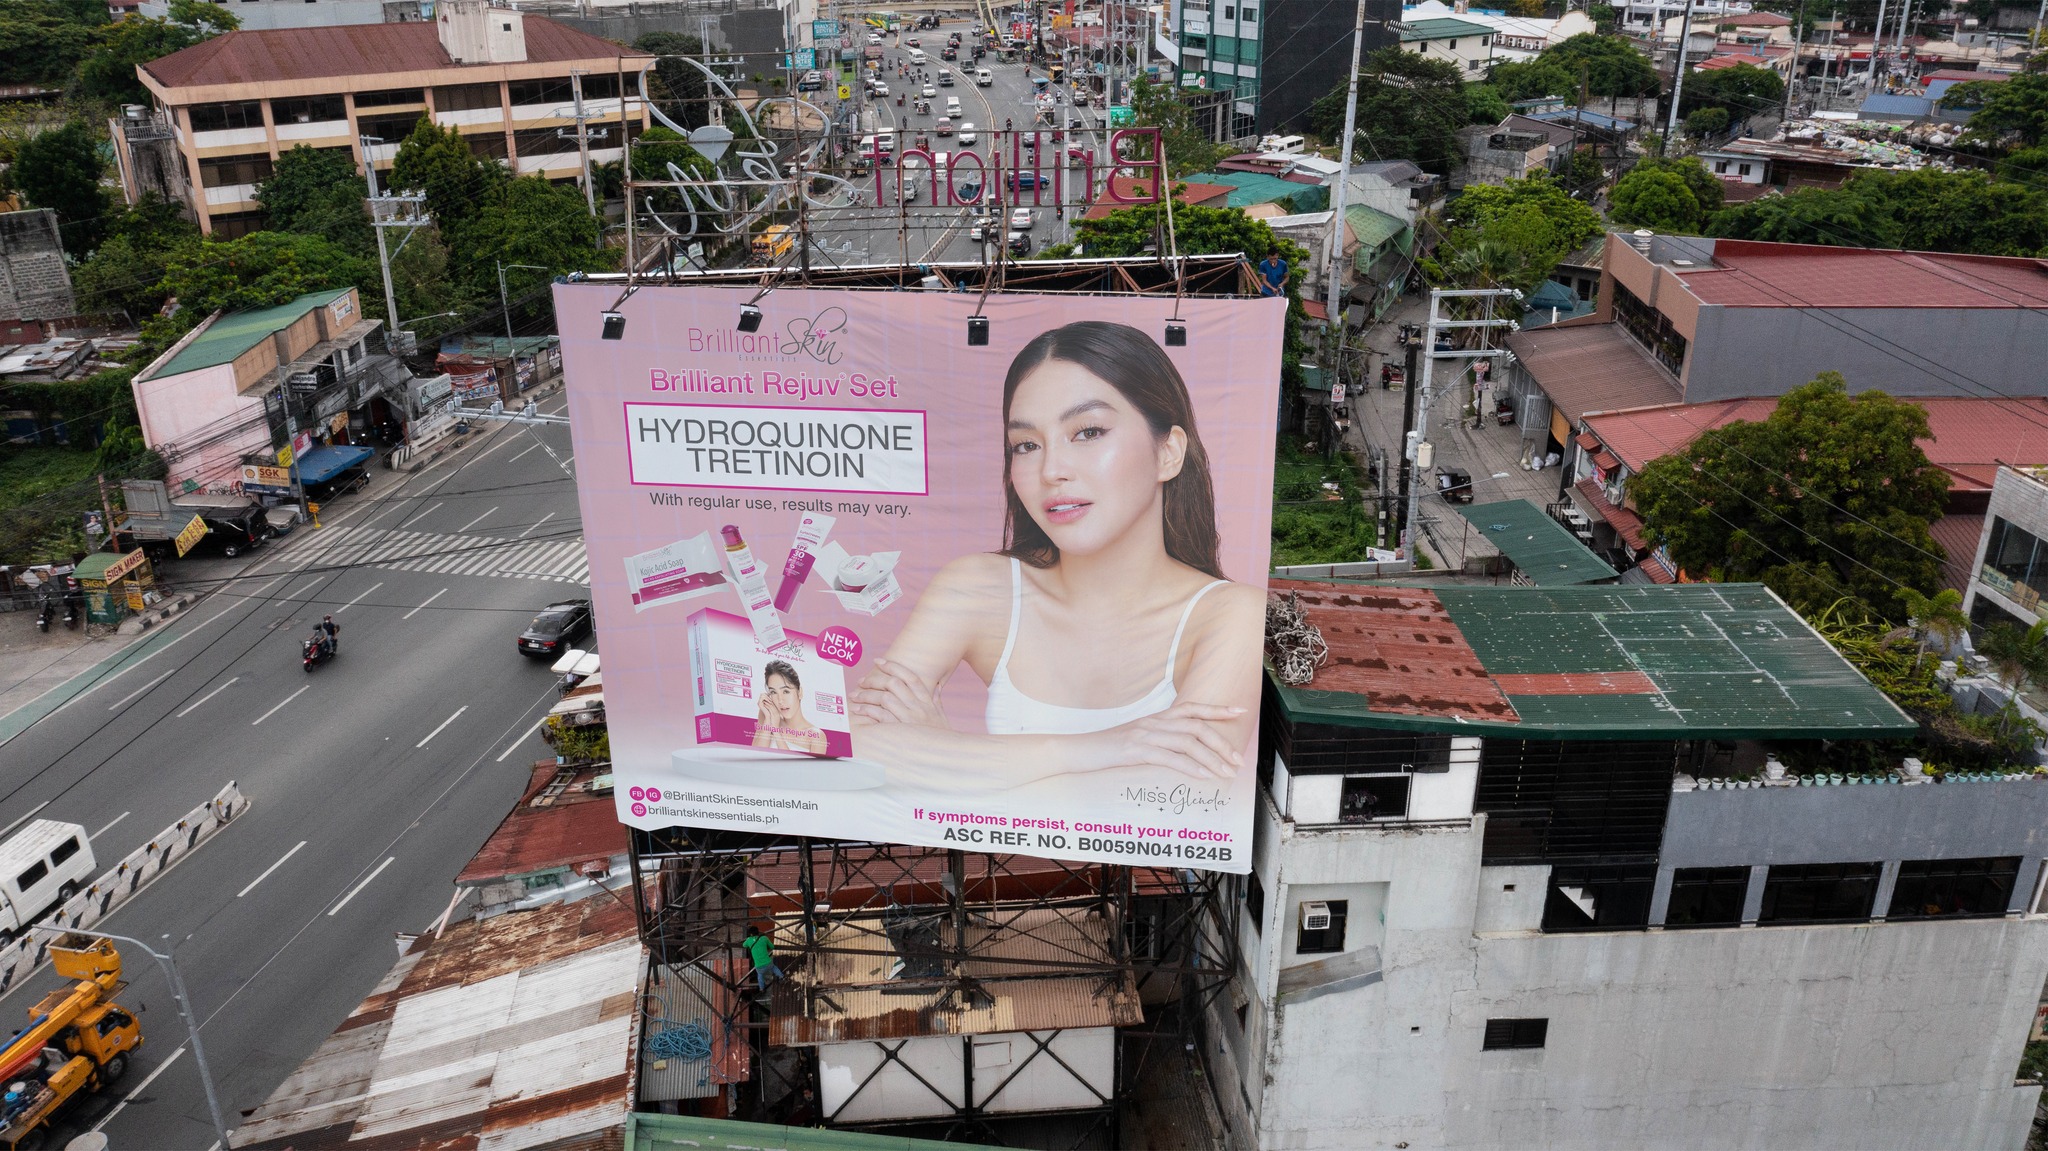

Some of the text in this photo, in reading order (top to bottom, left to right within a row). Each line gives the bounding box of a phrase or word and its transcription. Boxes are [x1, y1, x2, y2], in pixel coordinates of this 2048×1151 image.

[688, 327, 781, 354] Brilliant
[739, 354, 797, 362] Essentials
[650, 368, 753, 394] Brilliant
[850, 373, 898, 398] Set
[638, 418, 913, 451] HYDROQUINONE
[260, 468, 280, 477] SGK
[686, 448, 864, 478] TRETINOIN
[650, 492, 912, 518] With regular use, results may vary.
[106, 550, 144, 581] SIGN MAKER
[640, 558, 684, 577] Kojic Acid Soap
[82, 580, 107, 588] SIGN
[823, 632, 858, 650] NEW
[820, 643, 854, 662] LOOK
[754, 722, 784, 734] Brilliant
[785, 726, 806, 738] Rejuv
[807, 730, 820, 739] Set
[663, 790, 819, 810] @BrilliantSkinEssentialsMain
[1126, 786, 1167, 803] Miss
[648, 805, 780, 824] brilliantskinessentials.ph
[914, 808, 1233, 843] If symptoms persist, consult your doctor.
[944, 828, 1233, 862] ASC REF. NO. B0059N041624B
